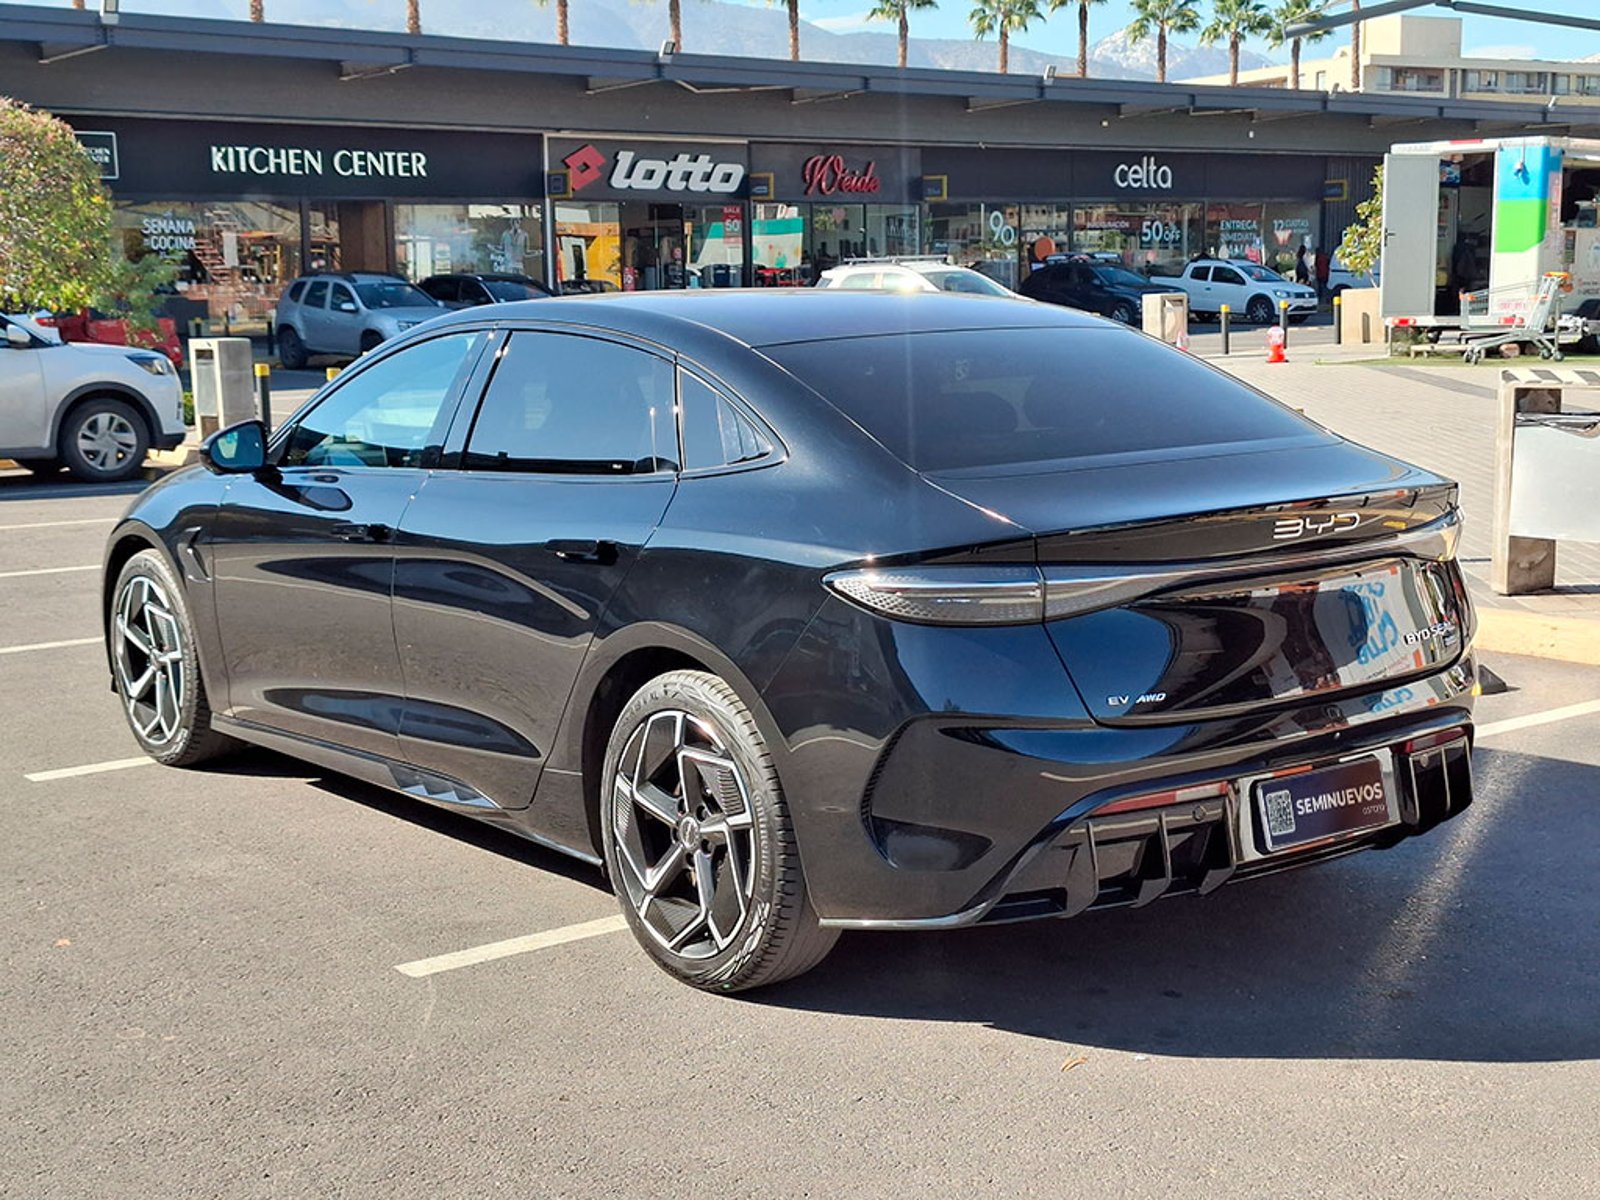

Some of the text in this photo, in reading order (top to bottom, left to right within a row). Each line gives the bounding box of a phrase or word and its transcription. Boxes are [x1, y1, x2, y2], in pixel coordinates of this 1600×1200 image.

[211, 146, 427, 177] KITCHEN CENTER
[609, 150, 745, 193] lotto
[805, 154, 881, 197] Weide
[1114, 156, 1172, 189] celta
[141, 218, 196, 234] SEMANA
[1221, 219, 1258, 231] ENTREGA
[151, 235, 196, 250] COCINA
[1273, 512, 1360, 539] BYD
[1108, 692, 1167, 706] EV AWD
[1296, 782, 1383, 816] SEMINUEVOS
